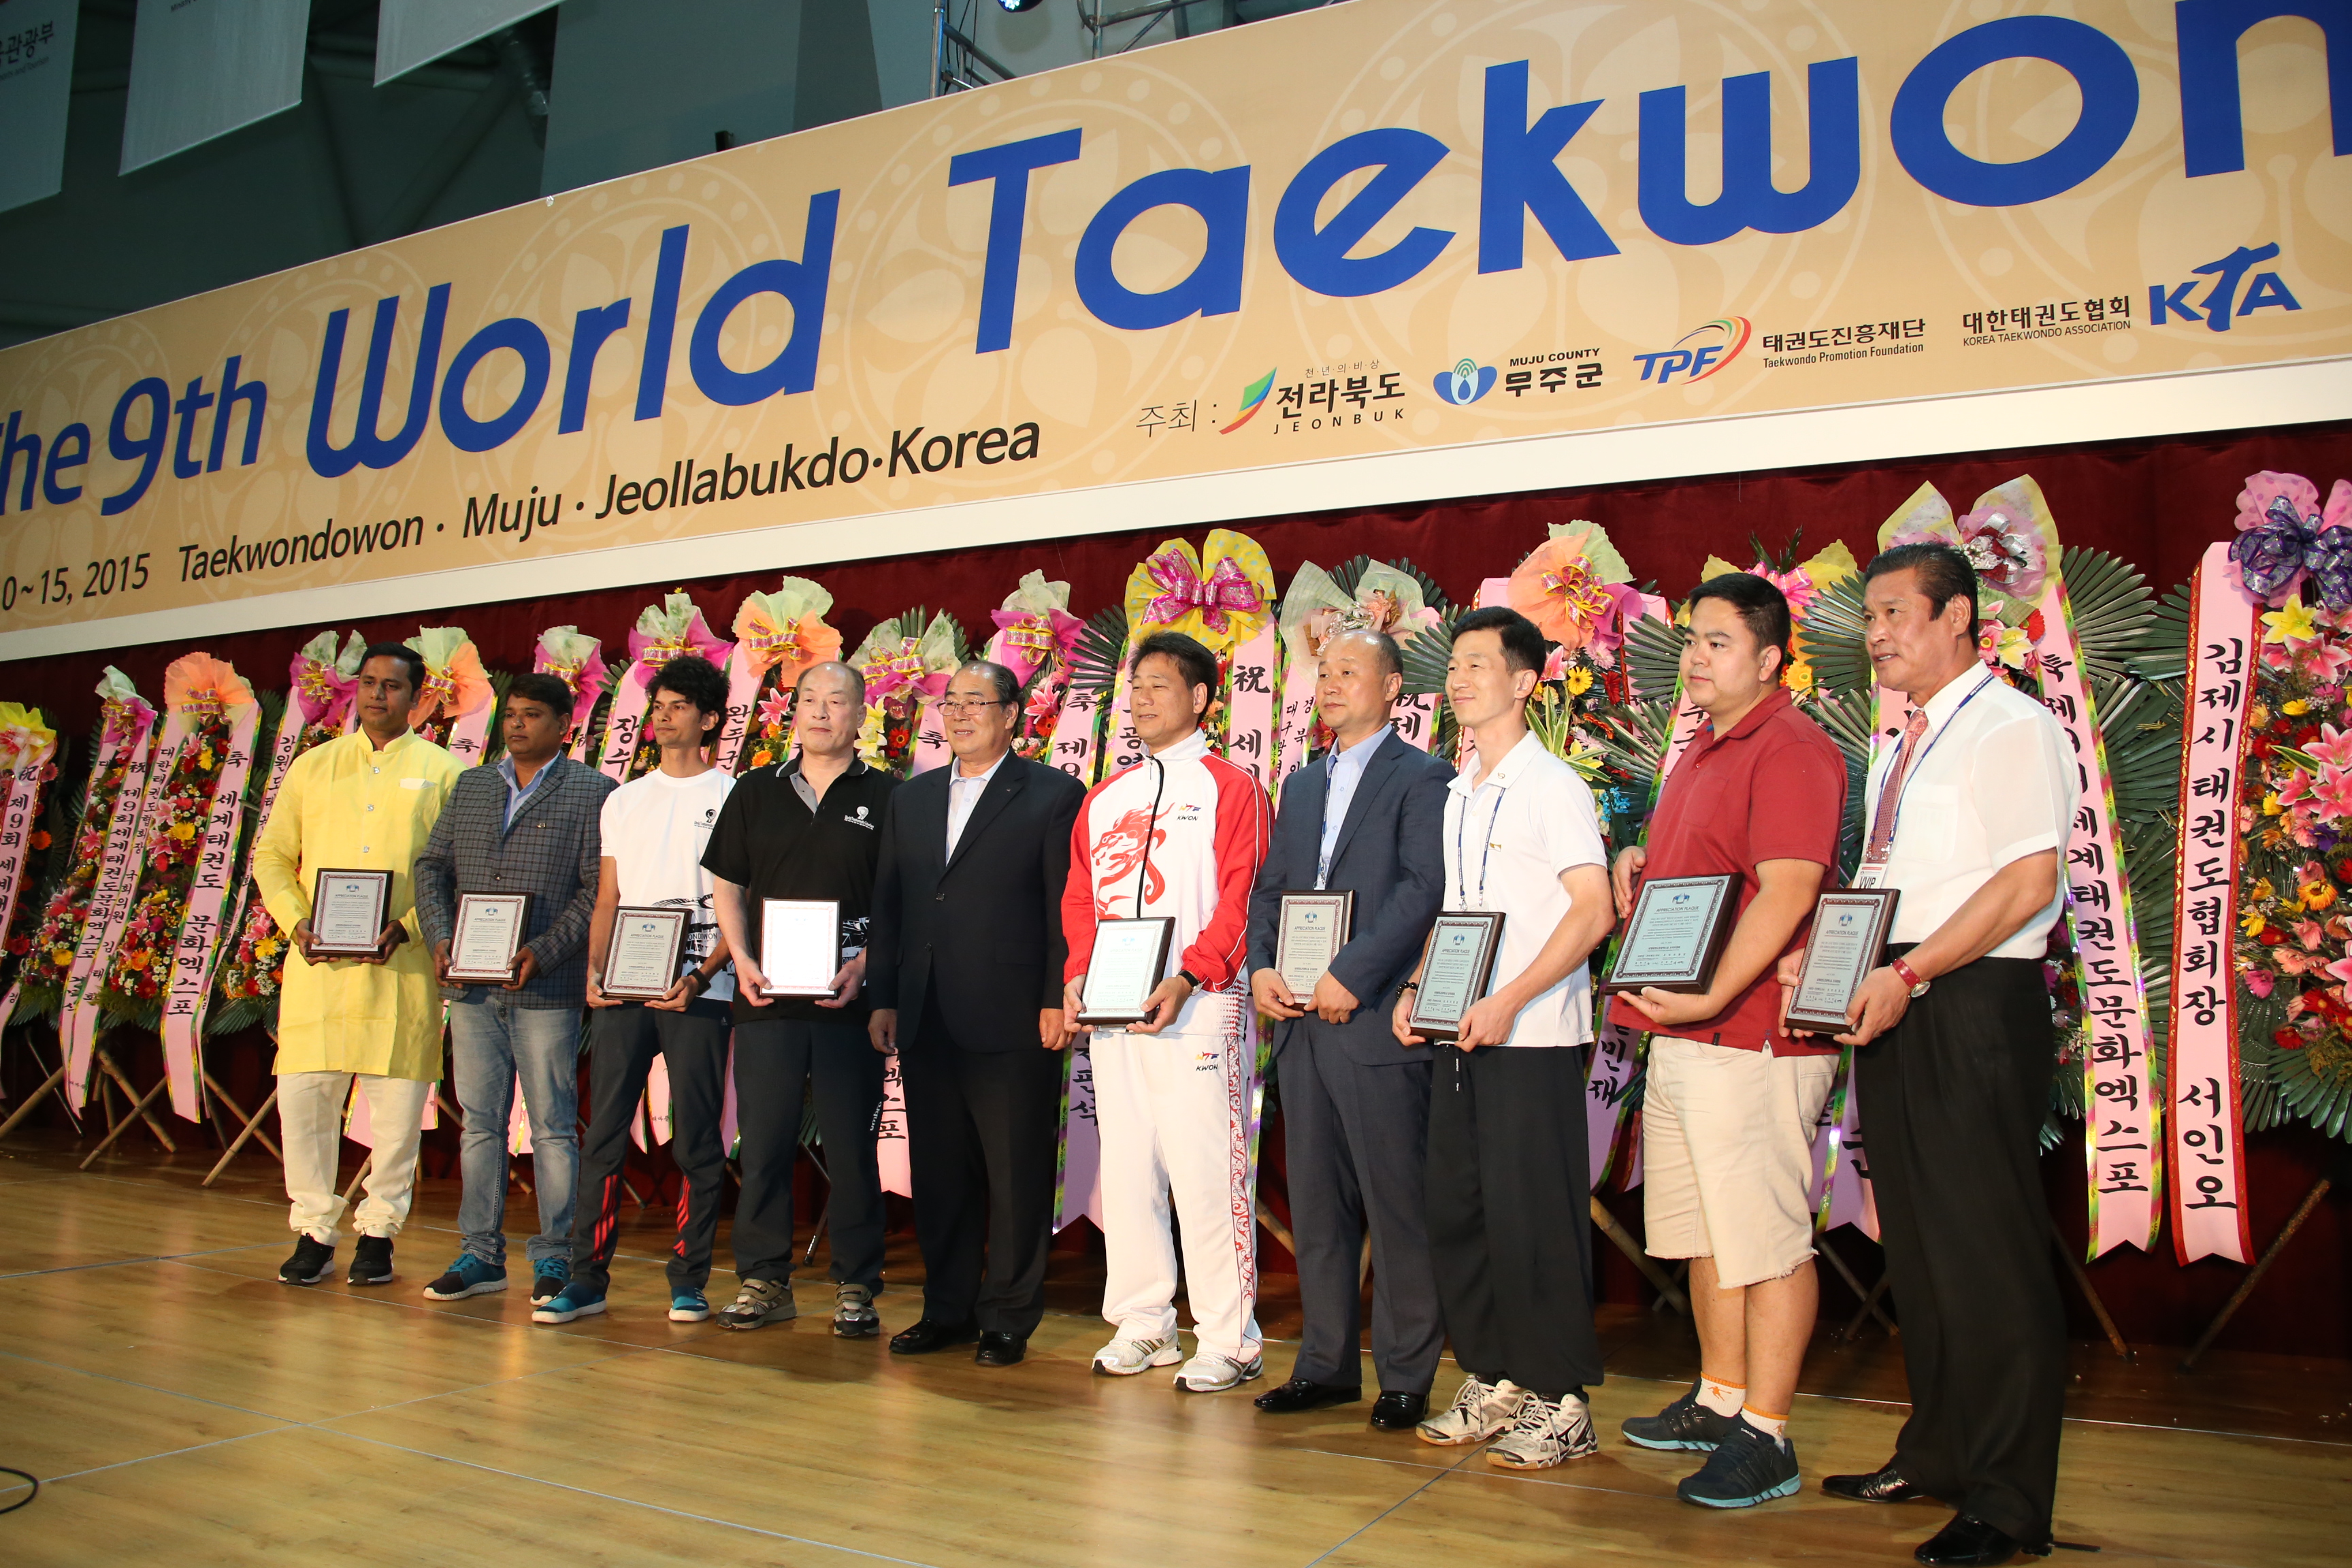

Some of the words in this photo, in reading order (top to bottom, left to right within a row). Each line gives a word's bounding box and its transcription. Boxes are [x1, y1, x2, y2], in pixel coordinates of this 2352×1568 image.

[0, 410, 91, 516] he
[101, 355, 267, 516] 9th
[306, 186, 840, 478] World
[948, 0, 2352, 355] Taekwon
[2149, 242, 2302, 332] KTA
[1962, 295, 2131, 336] 대한태권도협회
[1963, 336, 1996, 347] KOREA
[1998, 329, 2062, 343] TAEKWONDO
[2064, 320, 2132, 336] ASSOCIATION
[1763, 318, 1926, 354] 태권도진흥재단
[1509, 355, 1544, 368] MUJU
[1548, 348, 1600, 362] COUNTY
[1633, 345, 1724, 385] TPF
[1763, 353, 1816, 369] Taekwondo
[1819, 347, 1867, 363] Promotion
[1870, 342, 1924, 357] Foundation
[1275, 372, 1405, 419] 전라북도
[1505, 362, 1603, 397] 무주군
[1136, 400, 1197, 438] 주최
[1273, 408, 1404, 434] JEONBUK
[82, 553, 150, 598] 2015
[179, 516, 423, 583] Taekwondowon
[463, 486, 562, 542] Muju
[1232, 665, 1271, 693] 祝
[2193, 638, 2243, 753] 김제시
[1066, 693, 1098, 713] 축
[226, 751, 249, 768] 축
[195, 790, 238, 889] 세계태권도
[2180, 767, 2232, 1026] 태권도협회장
[167, 915, 217, 1015] 문화엑스포
[1196, 1064, 1218, 1072] KWON
[870, 1101, 882, 1131] umbro
[2177, 1077, 2238, 1210] 서인오
